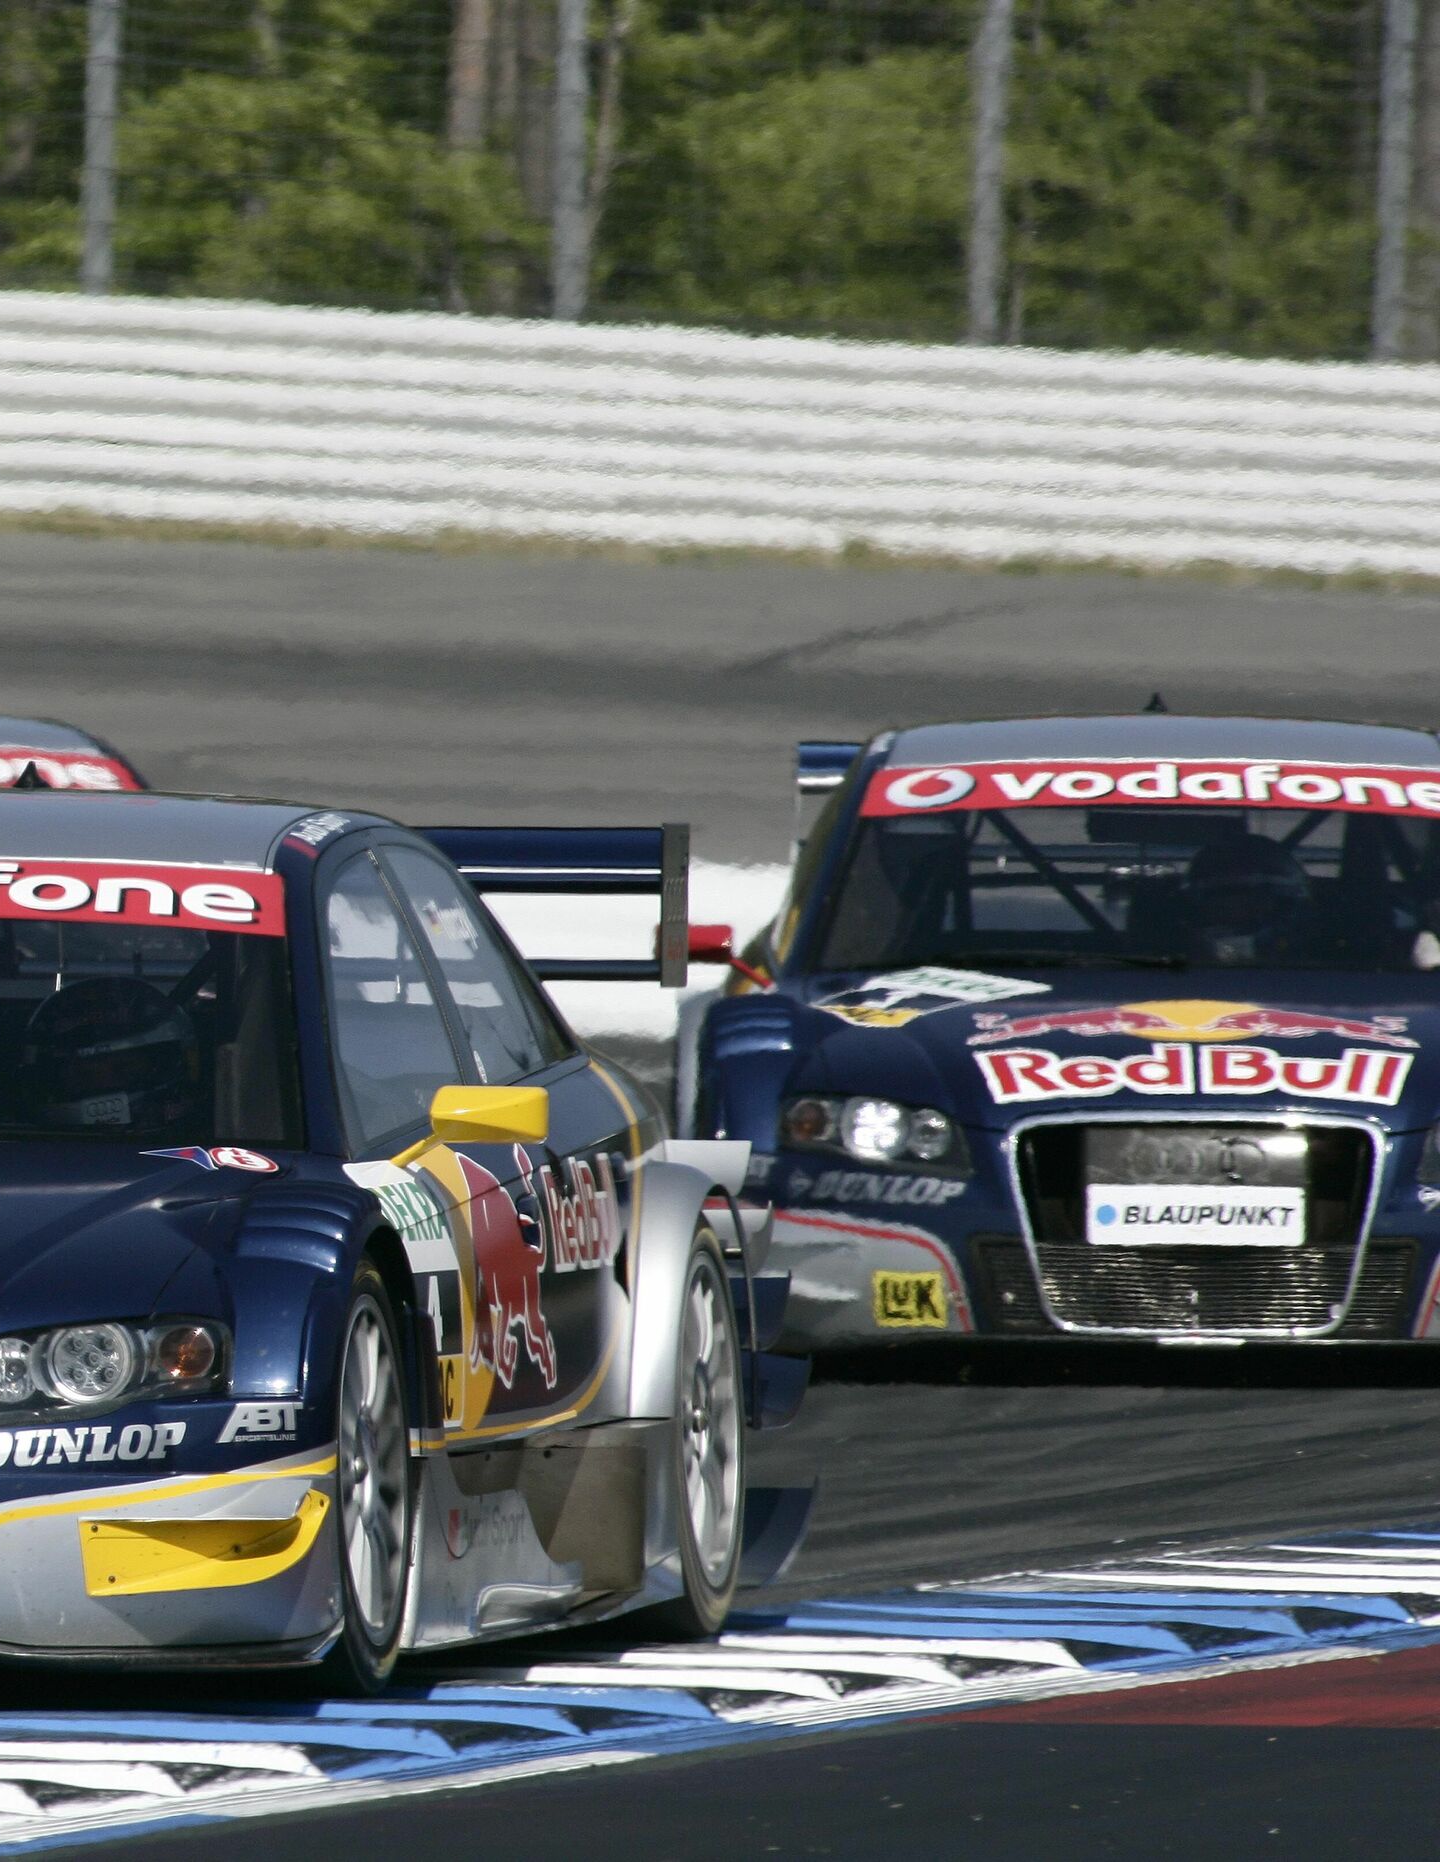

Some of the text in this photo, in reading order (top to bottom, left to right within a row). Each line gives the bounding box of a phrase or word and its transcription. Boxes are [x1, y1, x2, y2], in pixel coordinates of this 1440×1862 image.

[990, 763, 1440, 813] vodafone
[979, 1043, 1411, 1103] Red Bull
[812, 1171, 967, 1205] DUNLOP
[1122, 1204, 1298, 1229] BLAUPUNKT
[216, 1402, 304, 1444] ABT
